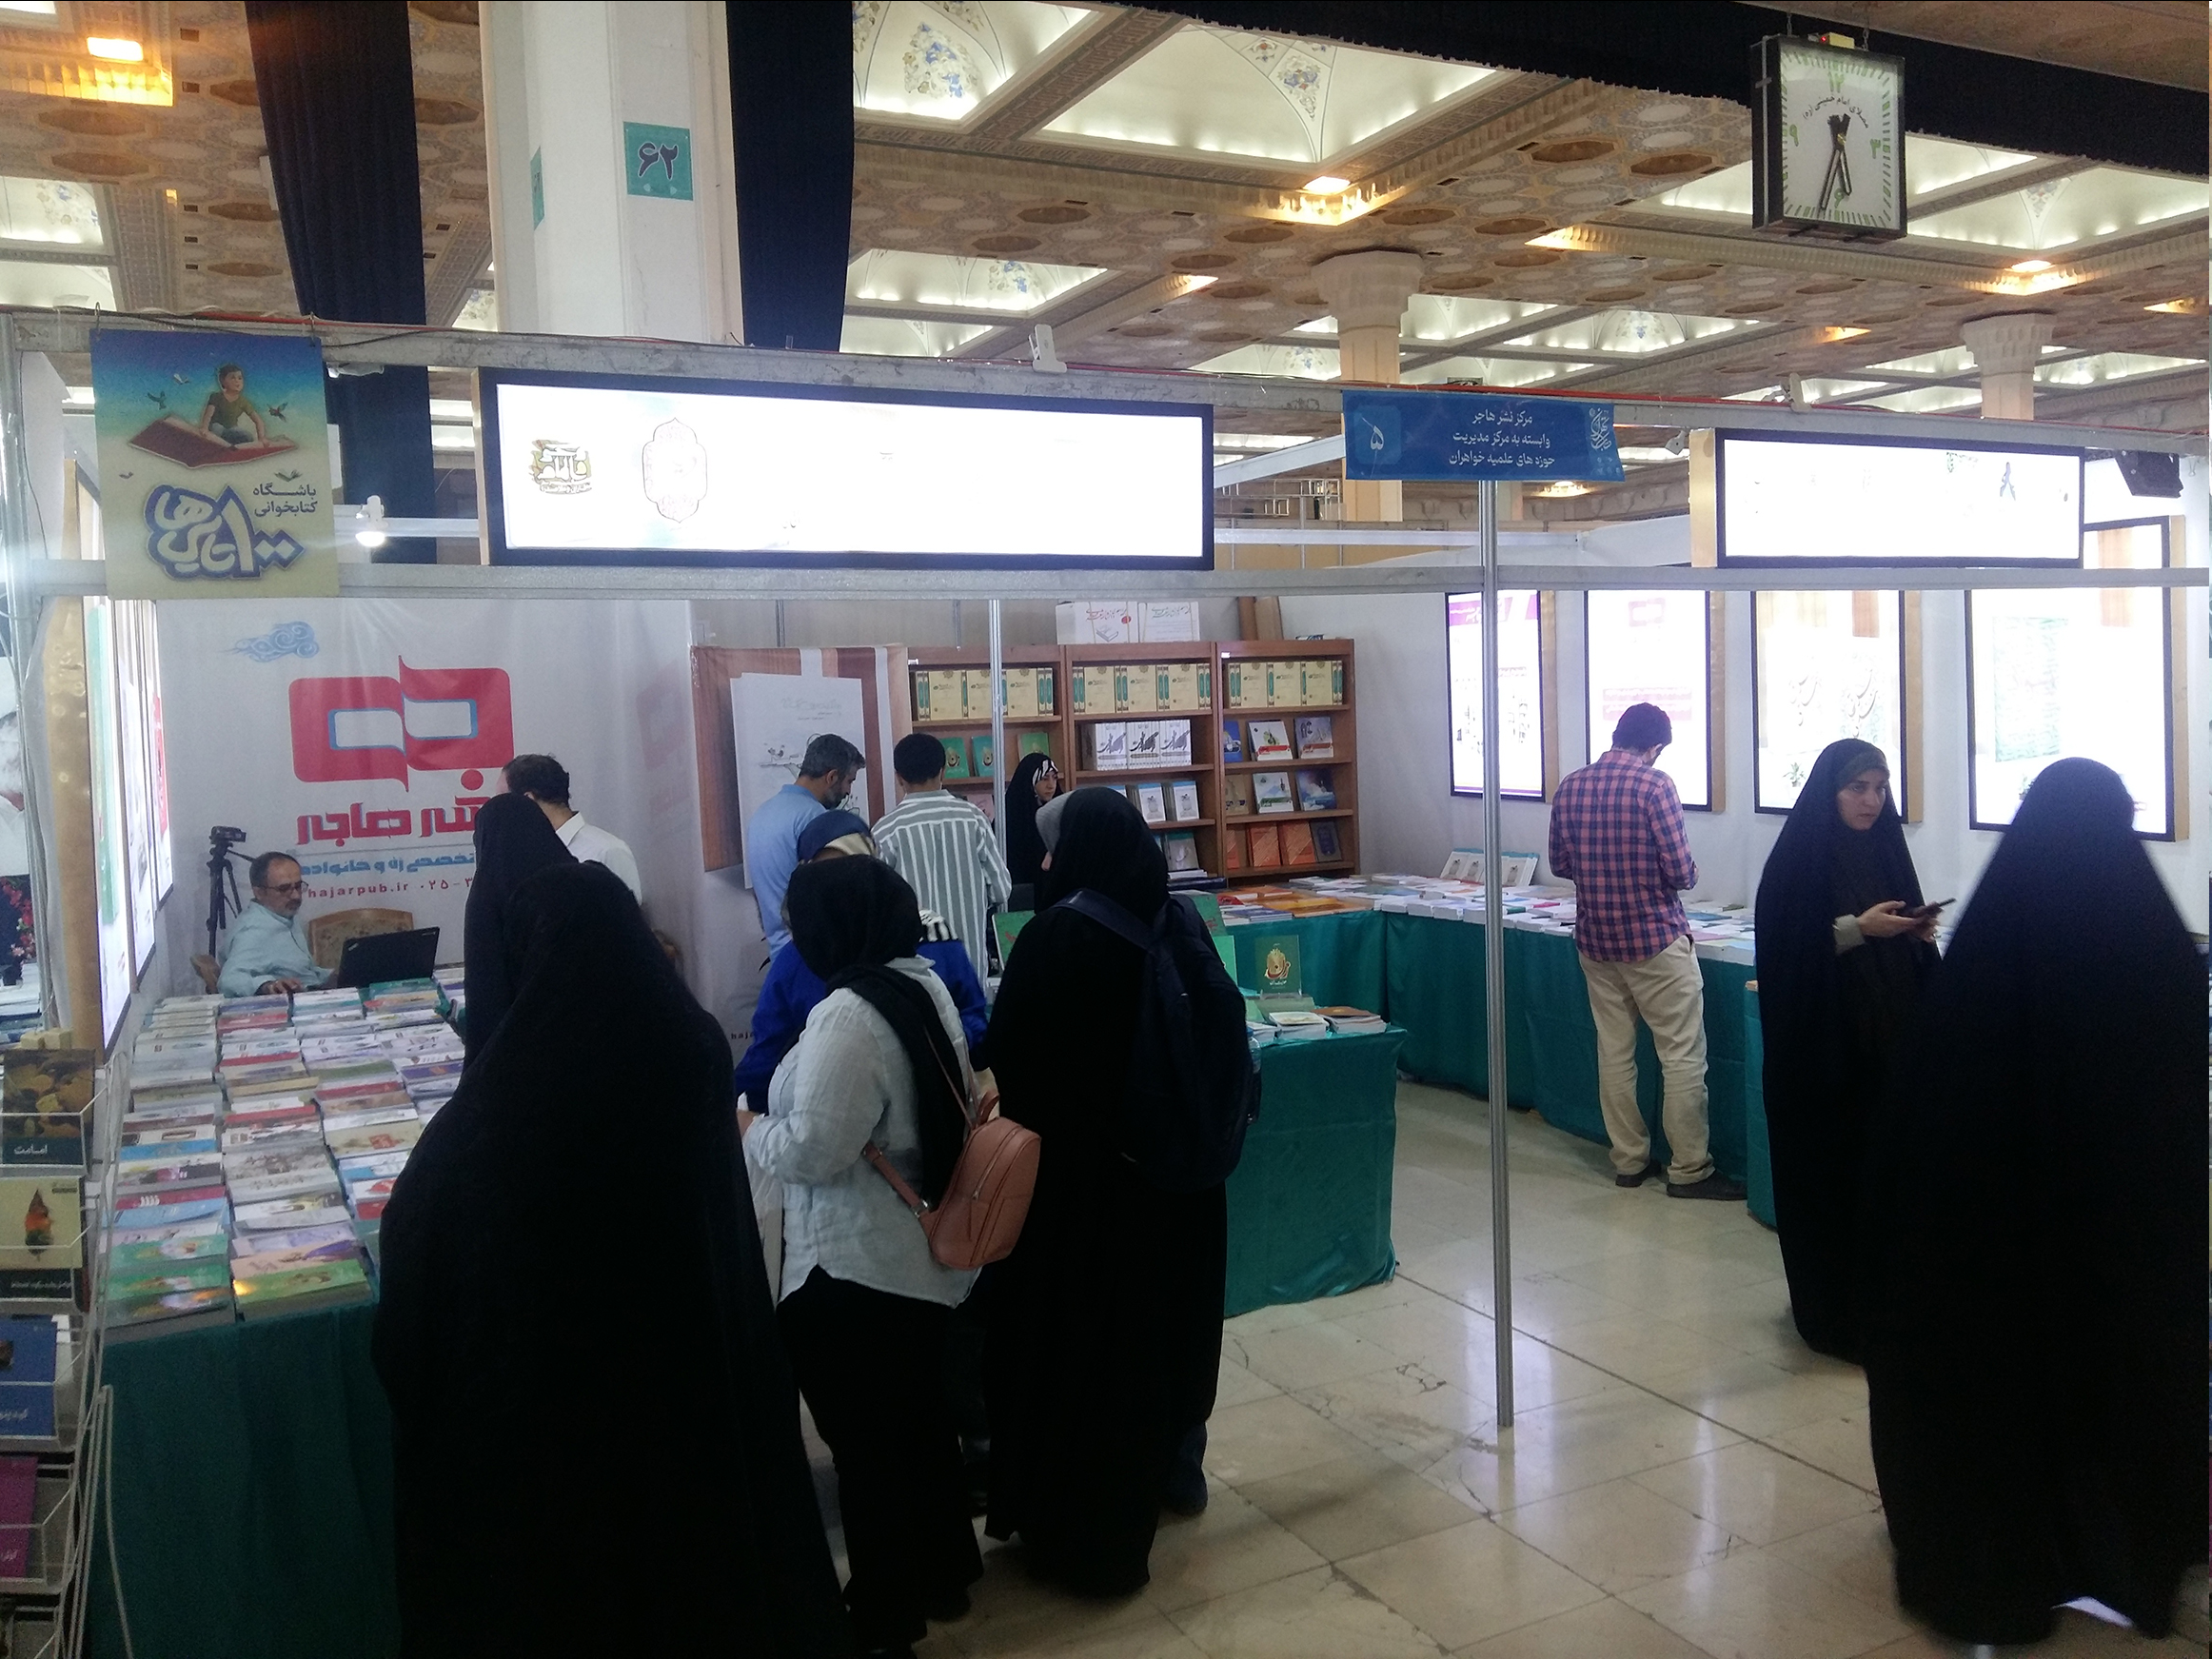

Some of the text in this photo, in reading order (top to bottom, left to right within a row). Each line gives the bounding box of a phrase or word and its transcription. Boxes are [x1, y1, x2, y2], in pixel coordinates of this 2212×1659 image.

[1836, 96, 1850, 105] امام
[1788, 124, 1799, 147] ۹
[638, 141, 679, 180] ۶۲
[1471, 408, 1533, 426] مرکز نشر هاجر
[1370, 425, 1385, 450] ۵
[1452, 429, 1551, 449] وابسته به مرکز مدیریت
[1449, 449, 1555, 468] حوزه های علمیه خواهران
[252, 483, 317, 500] باشگاه
[254, 501, 318, 518] کتابخوانی
[295, 796, 492, 847] شر هاجر
[373, 860, 385, 875] و
[388, 856, 404, 873] زن
[307, 881, 408, 899] hajarpub.ir
